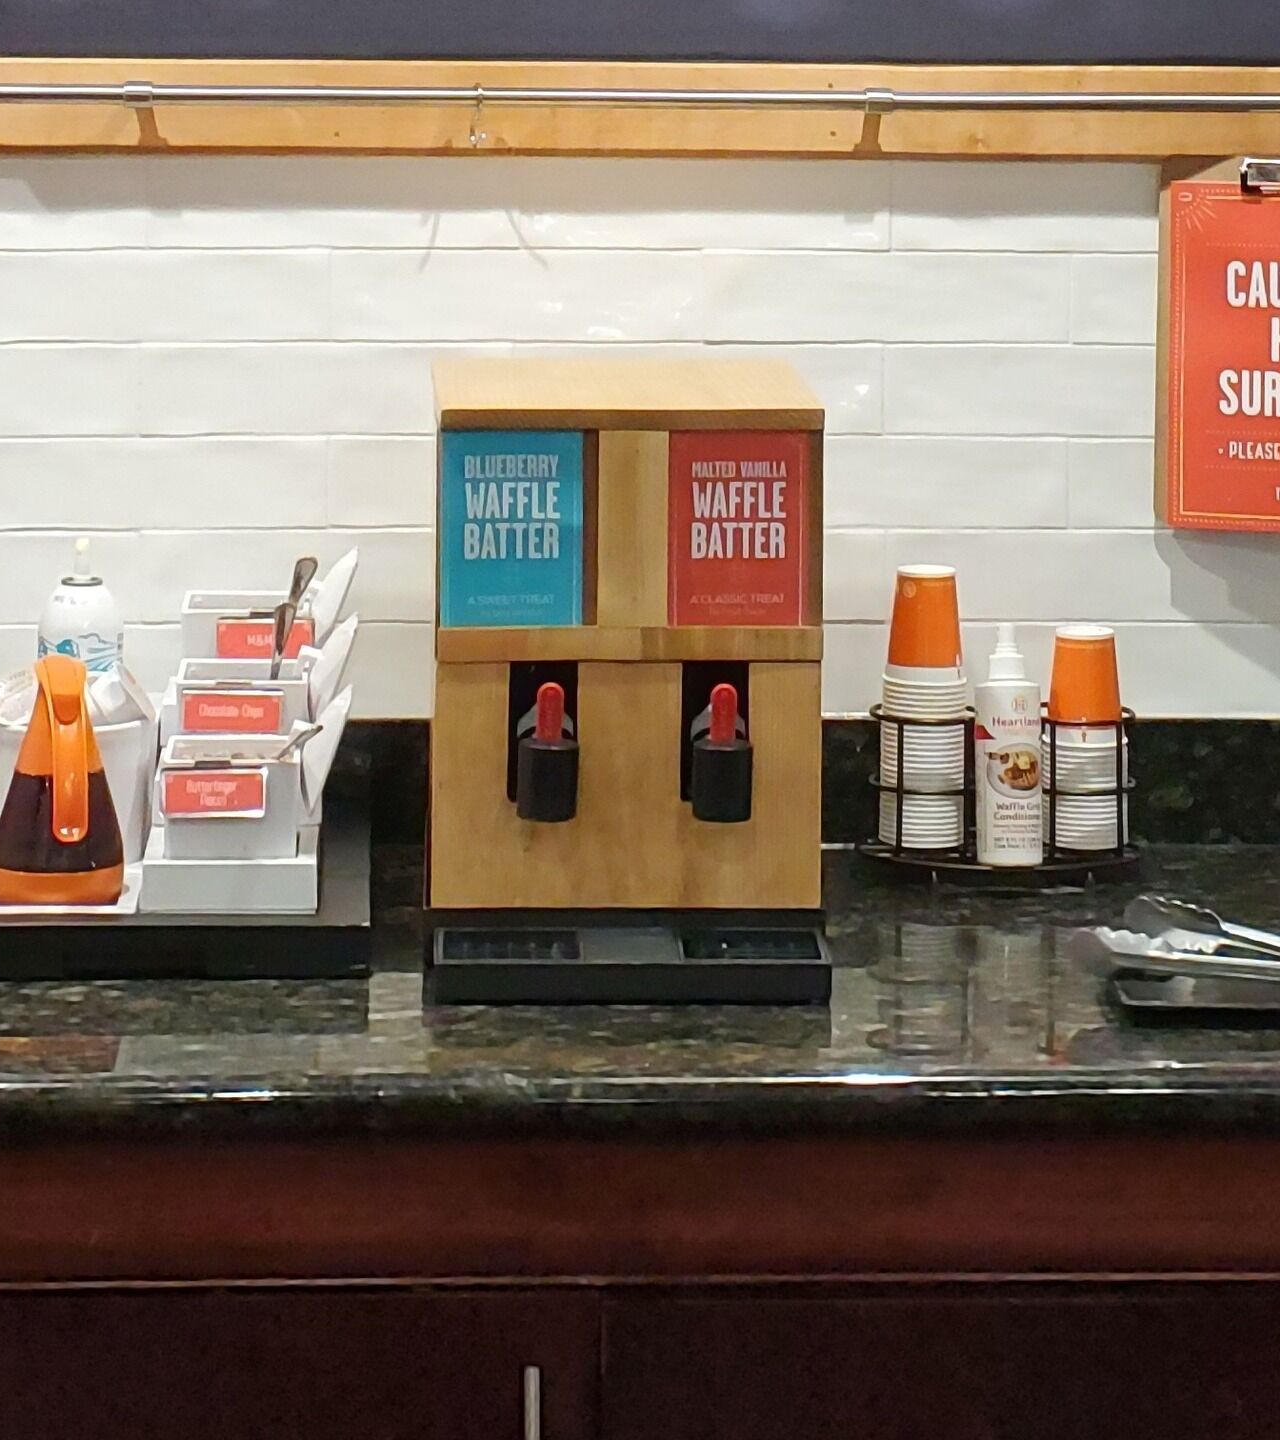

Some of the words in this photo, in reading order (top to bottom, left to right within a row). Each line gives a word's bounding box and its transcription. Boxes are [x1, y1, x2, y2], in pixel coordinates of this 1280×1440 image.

[1229, 441, 1280, 460] PLEASE
[464, 454, 559, 479] BLUEBERRY
[692, 461, 736, 478] MALTED
[740, 461, 787, 478] VANILLA
[465, 482, 561, 519] WAFFLE
[692, 481, 787, 519] WAFFLE
[464, 522, 560, 560] BATTER
[691, 522, 786, 559] BATTER
[467, 595, 476, 605] A
[520, 593, 555, 605] TREAT
[689, 594, 699, 605] A
[700, 593, 748, 605] CLASSIC
[751, 592, 785, 604] TREAT
[247, 634, 275, 647] M&M
